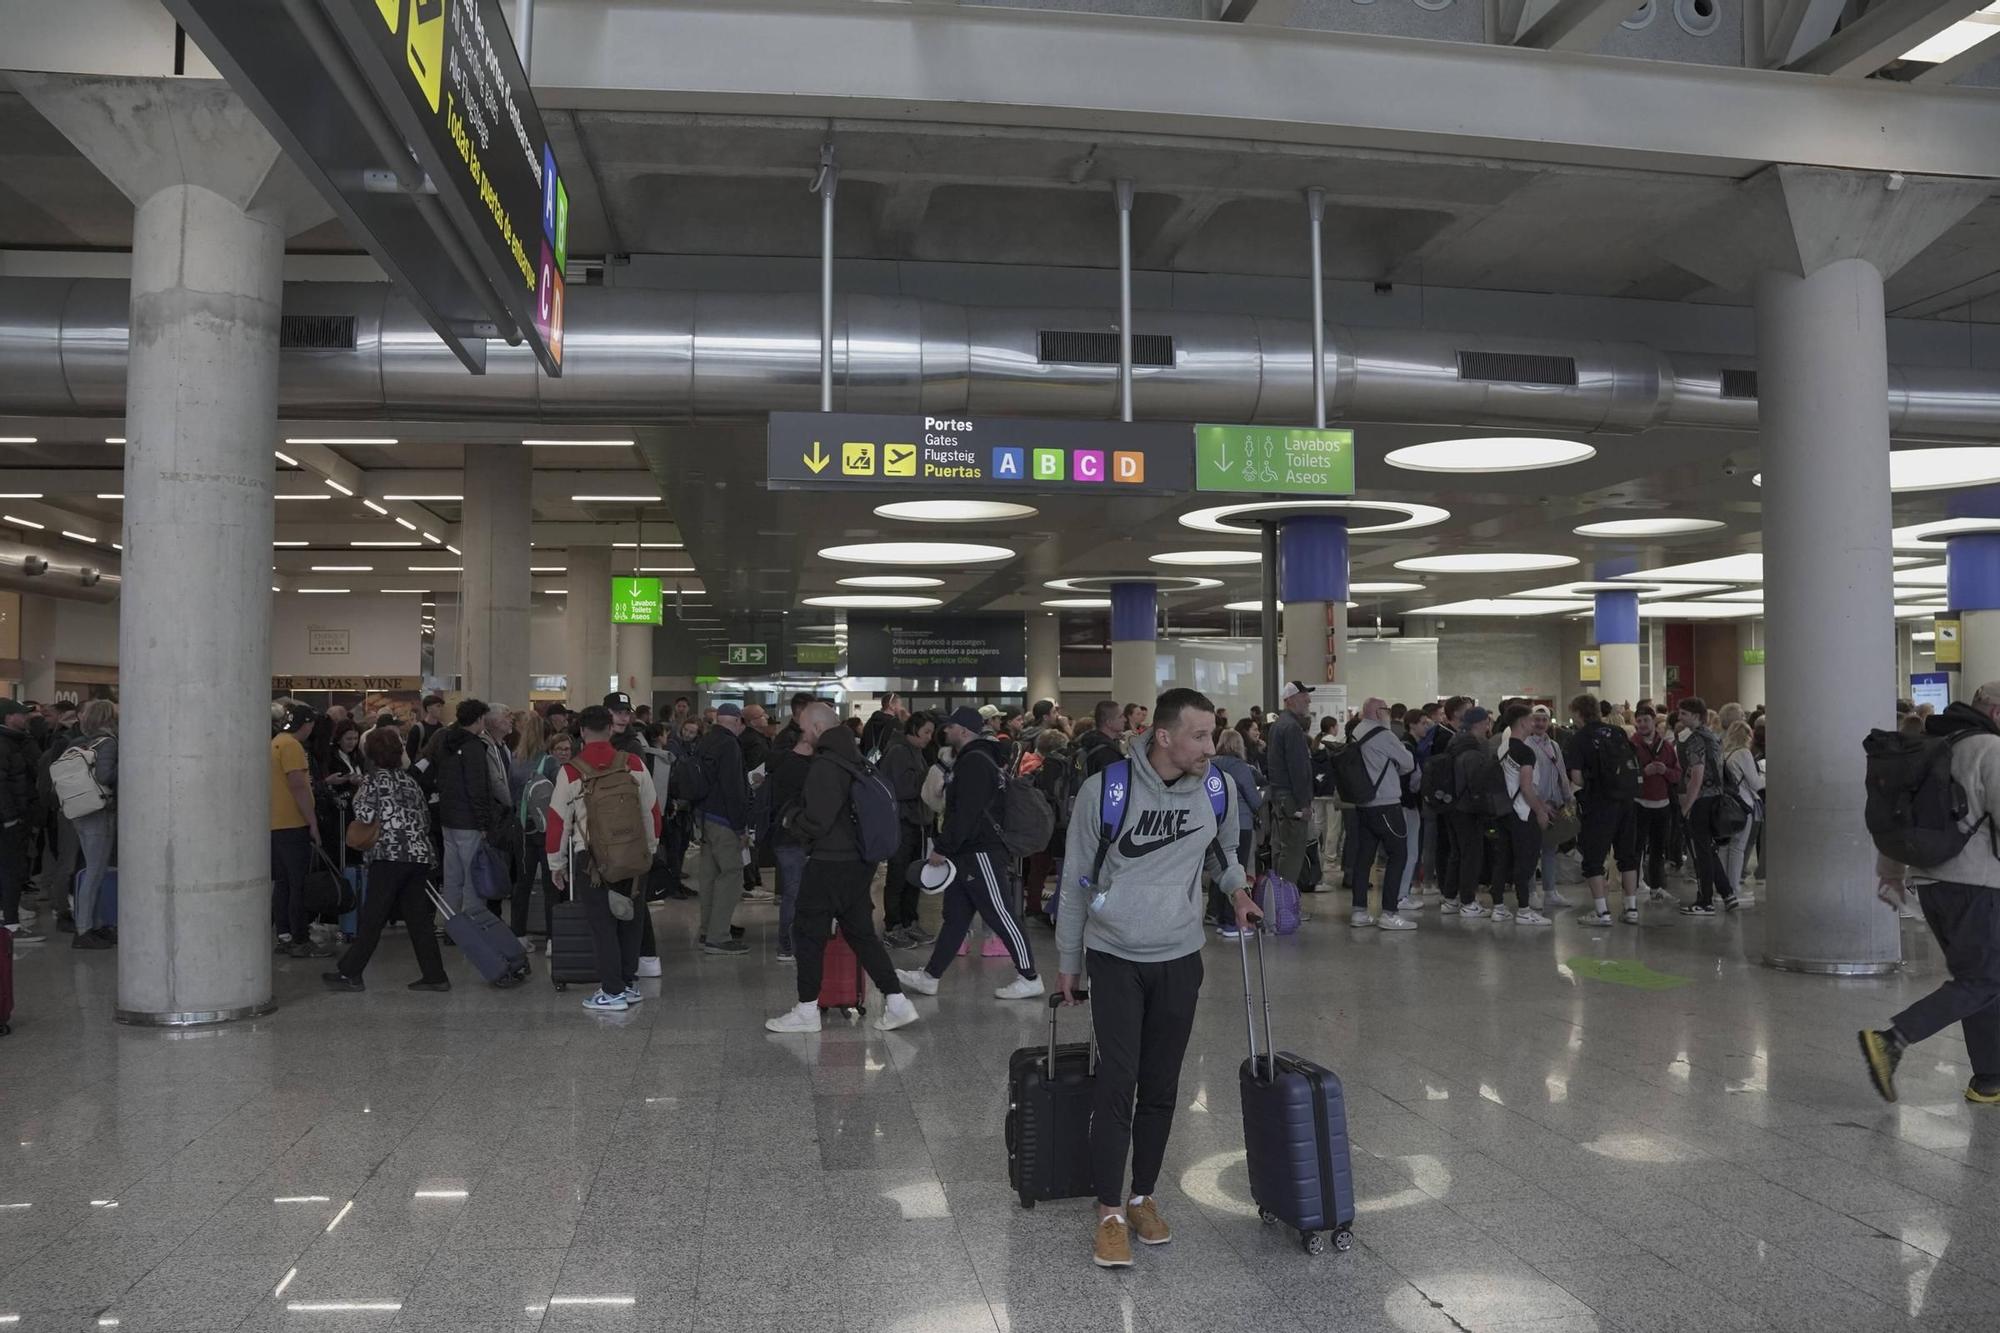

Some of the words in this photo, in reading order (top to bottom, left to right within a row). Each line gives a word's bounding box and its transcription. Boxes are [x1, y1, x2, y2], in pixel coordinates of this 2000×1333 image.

[475, 1, 485, 49] les
[485, 36, 505, 98] portes
[460, 16, 485, 98] boarding
[485, 82, 499, 125] gates
[446, 91, 470, 164] Todas
[469, 140, 481, 185] las
[480, 169, 505, 231] puertas
[503, 212, 512, 246] de
[511, 234, 536, 292] embarque
[545, 168, 554, 228] A
[558, 198, 565, 250] B
[541, 265, 550, 321] C
[554, 289, 561, 342] D
[924, 416, 973, 431] Portes
[925, 434, 958, 447] Gates
[1284, 436, 1341, 452] Lavabos
[924, 449, 976, 464] Flugsteig
[1285, 453, 1331, 468] Toilets
[924, 464, 981, 478] Puertas
[999, 453, 1017, 474] A
[1041, 454, 1056, 475] B
[1080, 456, 1097, 476] C
[1120, 457, 1136, 477] D
[1286, 469, 1328, 484] Aseos
[892, 647, 918, 655] Oficina
[918, 647, 928, 655] de
[928, 646, 960, 655] atención
[966, 648, 1000, 657] pasajeros
[892, 656, 929, 666] Passenger
[930, 656, 956, 665] Service
[957, 656, 978, 665] Office
[306, 678, 352, 689] TAPAS
[363, 678, 402, 689] WINE
[1134, 809, 1191, 836] NIKE
